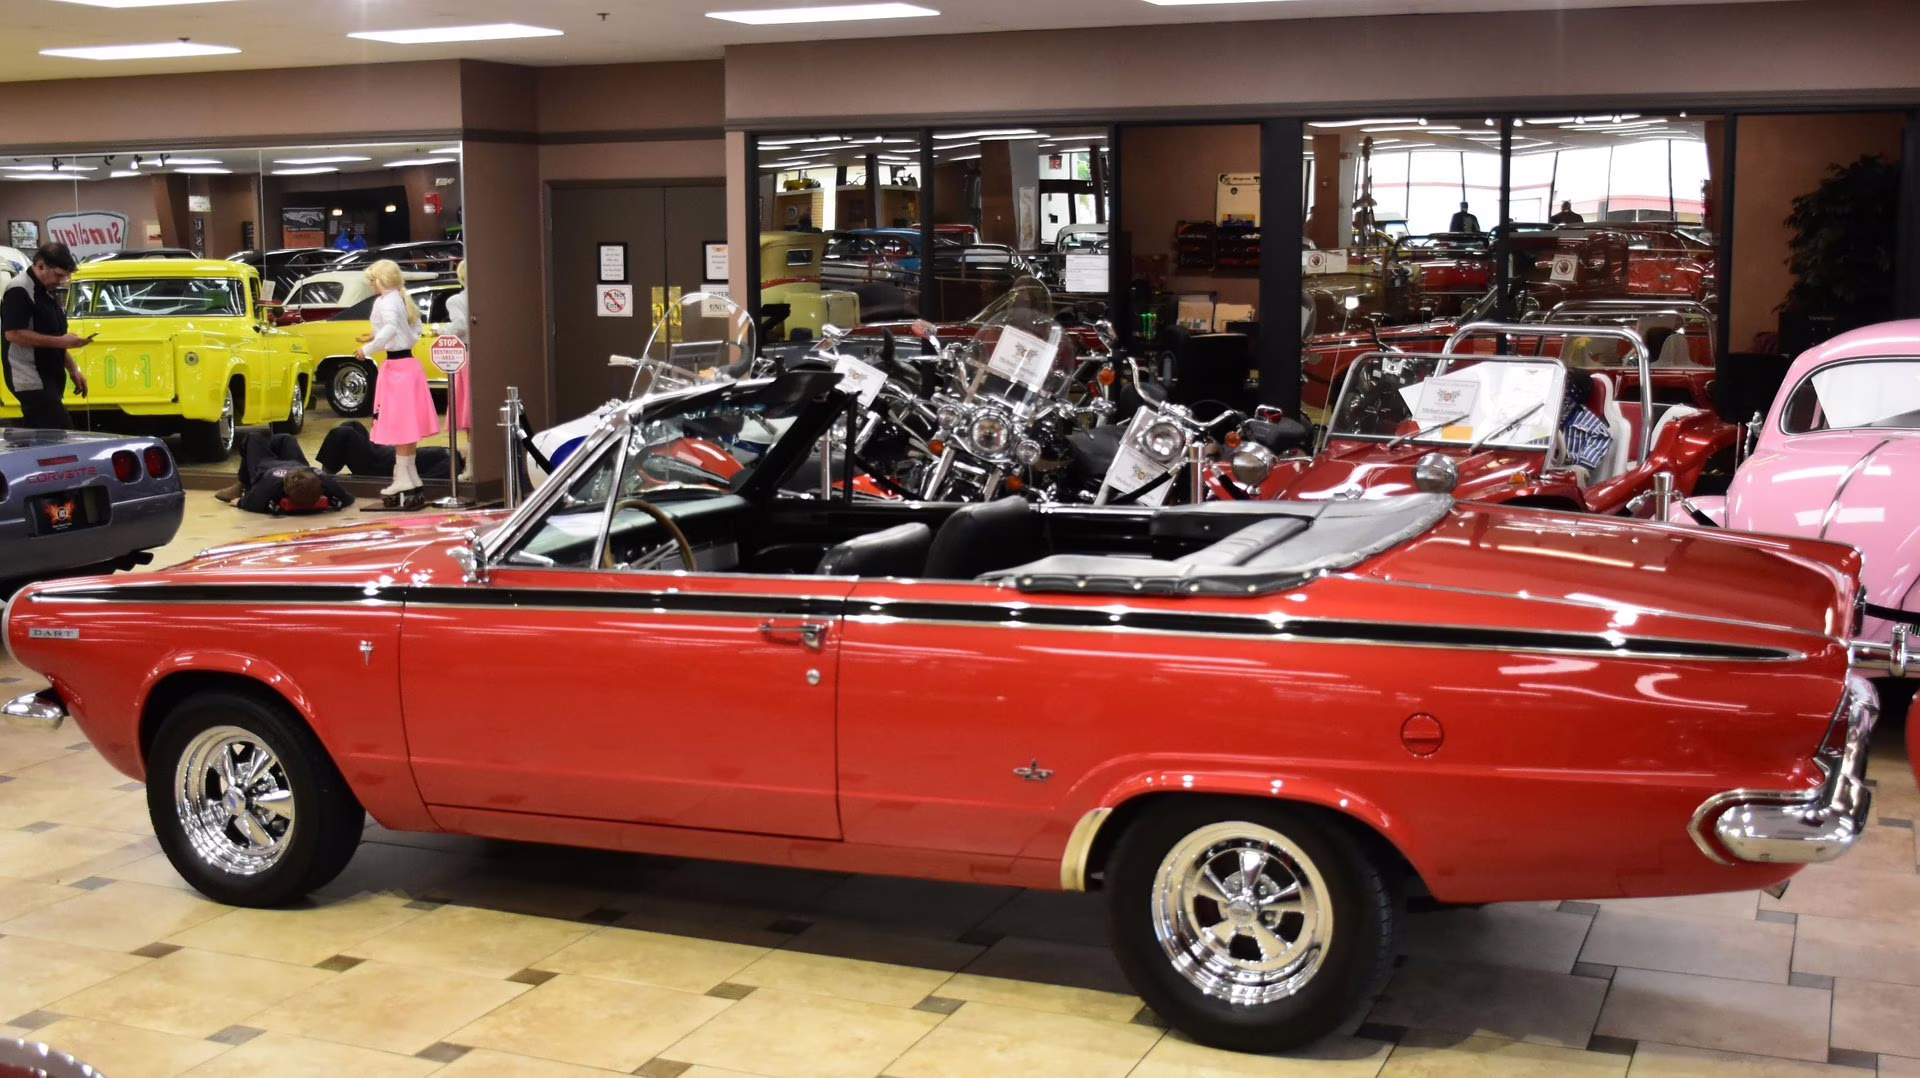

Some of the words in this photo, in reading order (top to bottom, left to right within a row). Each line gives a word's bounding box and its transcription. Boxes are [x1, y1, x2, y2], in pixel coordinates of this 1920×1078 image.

[438, 339, 458, 347] STOP
[28, 466, 97, 484] CORVETTE
[34, 629, 73, 637] DART
